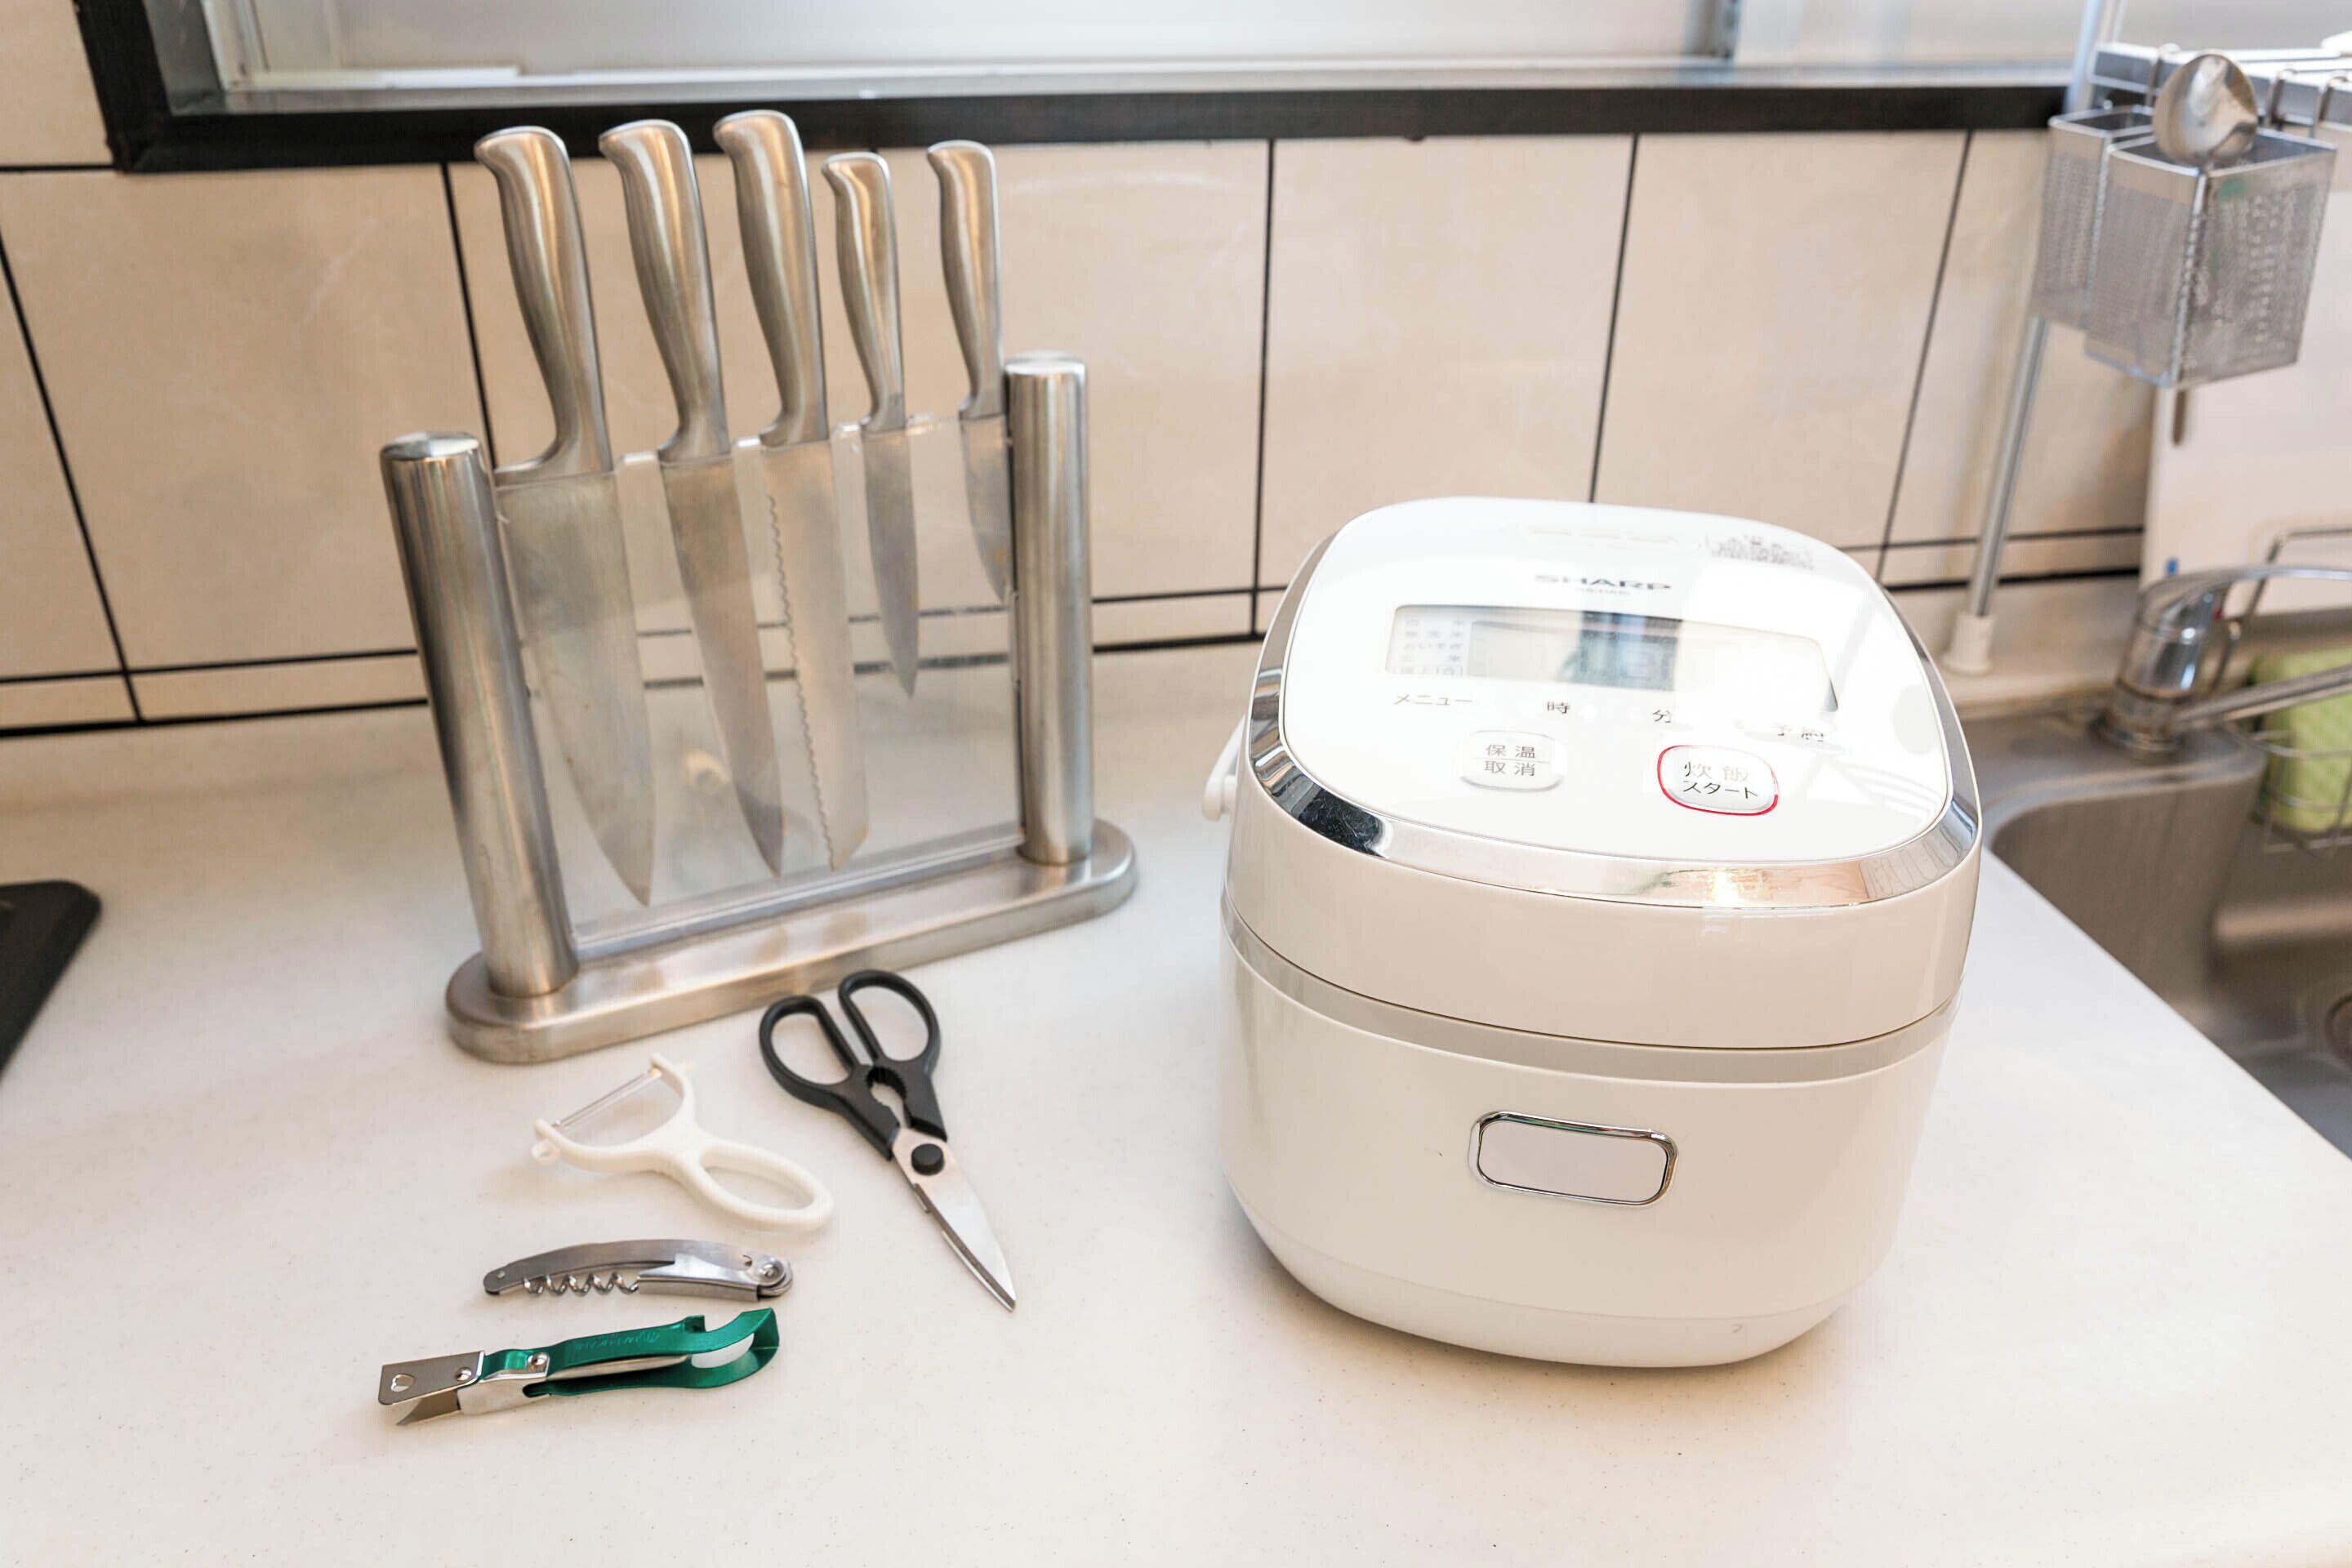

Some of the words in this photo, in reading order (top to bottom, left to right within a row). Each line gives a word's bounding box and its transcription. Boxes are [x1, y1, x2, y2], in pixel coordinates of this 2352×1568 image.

[1535, 575, 1672, 590] SHARP
[1393, 694, 1472, 706] メニュー
[1546, 702, 1570, 715] 時
[1652, 709, 1673, 724] 分
[1485, 744, 1536, 760] 保温
[1484, 760, 1535, 777] 取消
[1683, 761, 1750, 782] 炊飯
[1682, 780, 1758, 800] スタート
